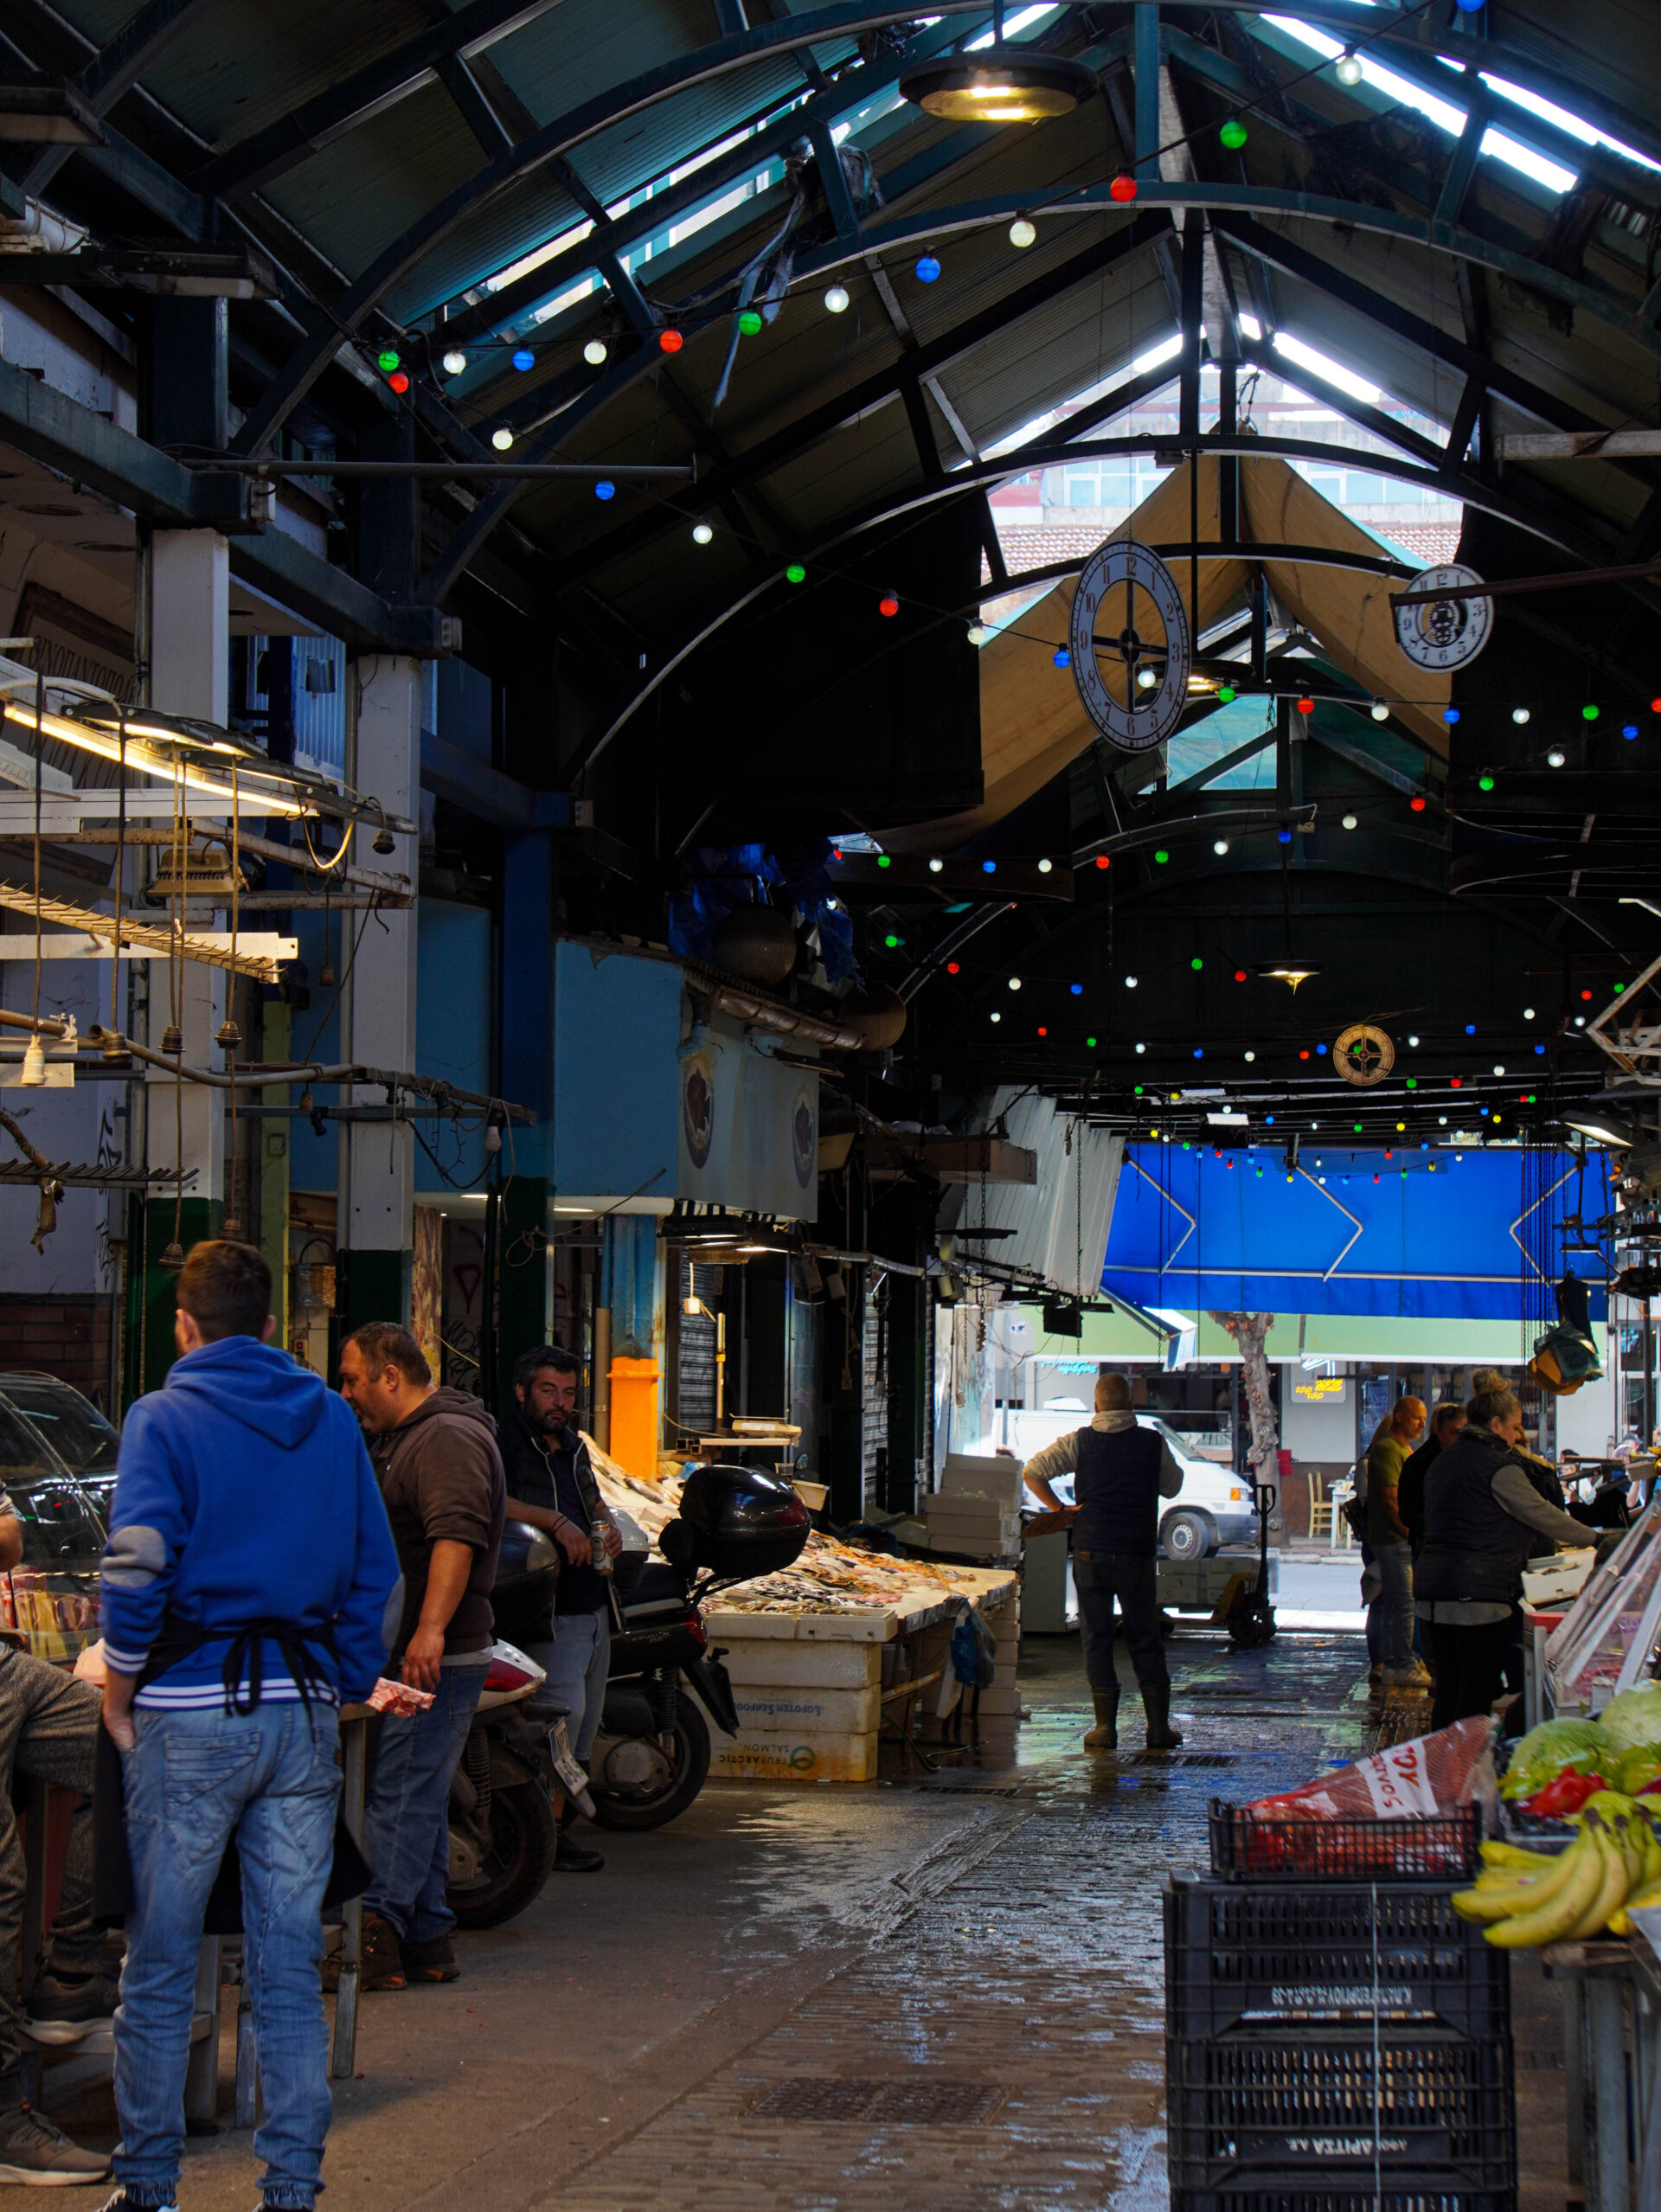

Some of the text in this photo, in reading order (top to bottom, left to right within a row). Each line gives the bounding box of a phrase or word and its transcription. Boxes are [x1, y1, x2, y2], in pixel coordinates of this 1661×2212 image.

[1102, 564, 1110, 584] 11
[1126, 555, 1137, 576] 12
[1151, 571, 1156, 590] 1
[1437, 573, 1447, 587] 12
[1086, 592, 1096, 612] 10
[1472, 604, 1482, 617] 3
[1166, 603, 1175, 623] 2
[1403, 618, 1412, 631] 9
[1468, 625, 1476, 638] 4
[1081, 630, 1088, 650] 9
[1408, 636, 1418, 649] 8
[1458, 641, 1465, 654] 5
[1171, 643, 1180, 663] 3
[1421, 646, 1428, 659] 7
[1439, 650, 1447, 662] 6
[1087, 670, 1096, 690] 8
[1166, 682, 1173, 702] 4
[1105, 701, 1111, 721] 7
[1151, 709, 1158, 728] 5
[1126, 717, 1135, 735] 6
[734, 1702, 774, 1715] SEAFOO
[744, 1743, 789, 1752] SALMON
[719, 1754, 786, 1766] TRUEARCTIC
[1311, 2138, 1374, 2155] ΔΡΙΤΣΑ
